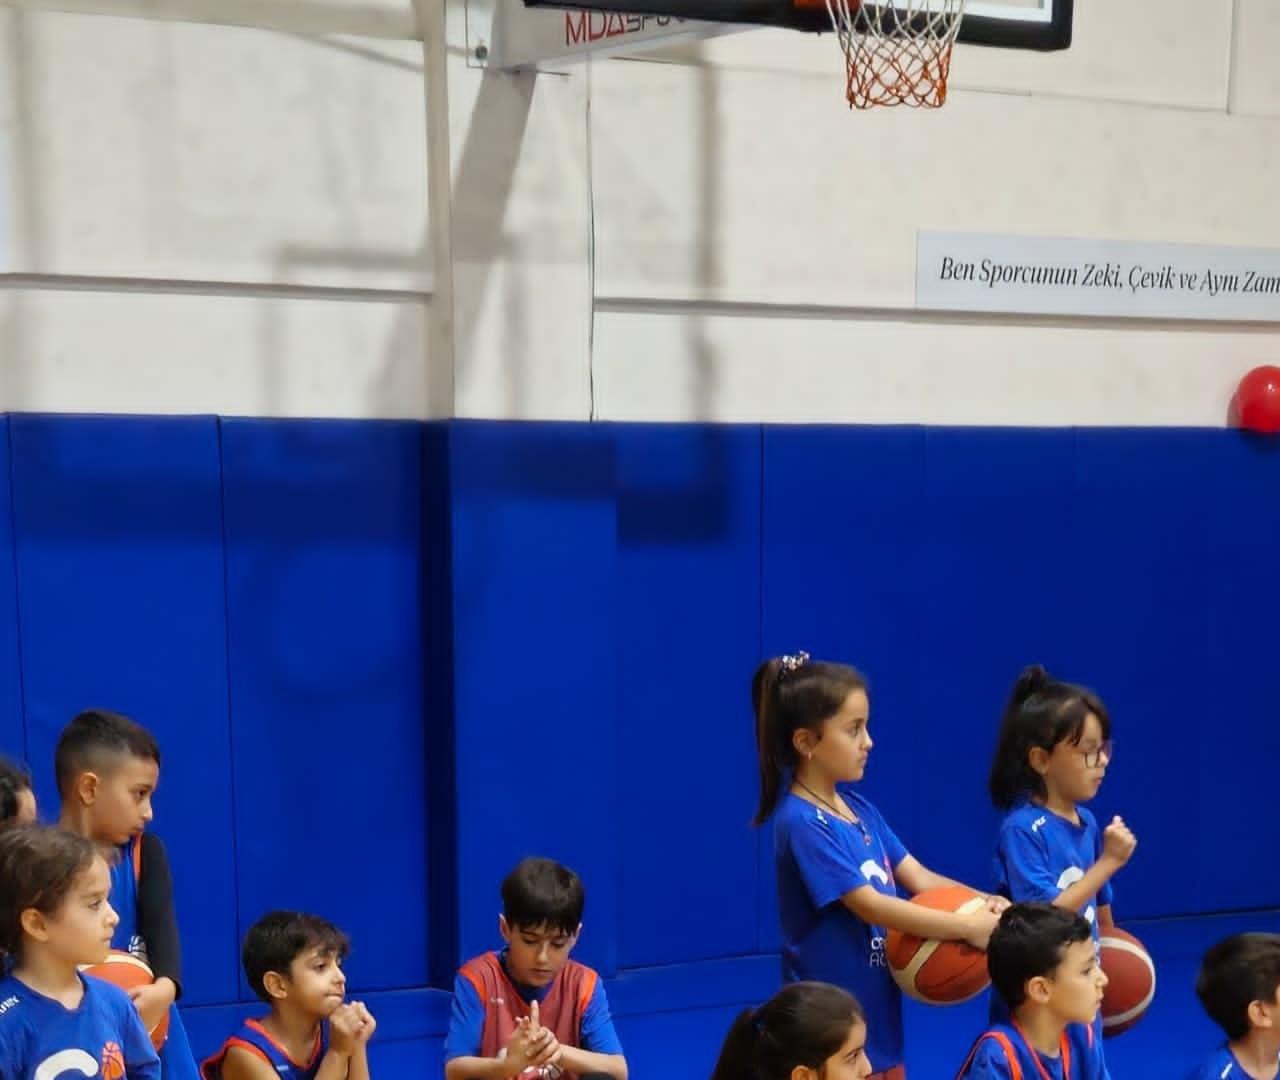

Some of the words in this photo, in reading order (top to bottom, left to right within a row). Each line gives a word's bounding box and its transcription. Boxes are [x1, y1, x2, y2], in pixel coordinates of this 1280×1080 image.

[940, 257, 974, 280] Ben
[978, 258, 1077, 288] Sporcunun
[1128, 265, 1175, 293] Çevik
[1179, 272, 1197, 290] ve
[1200, 269, 1239, 296] Aynı
